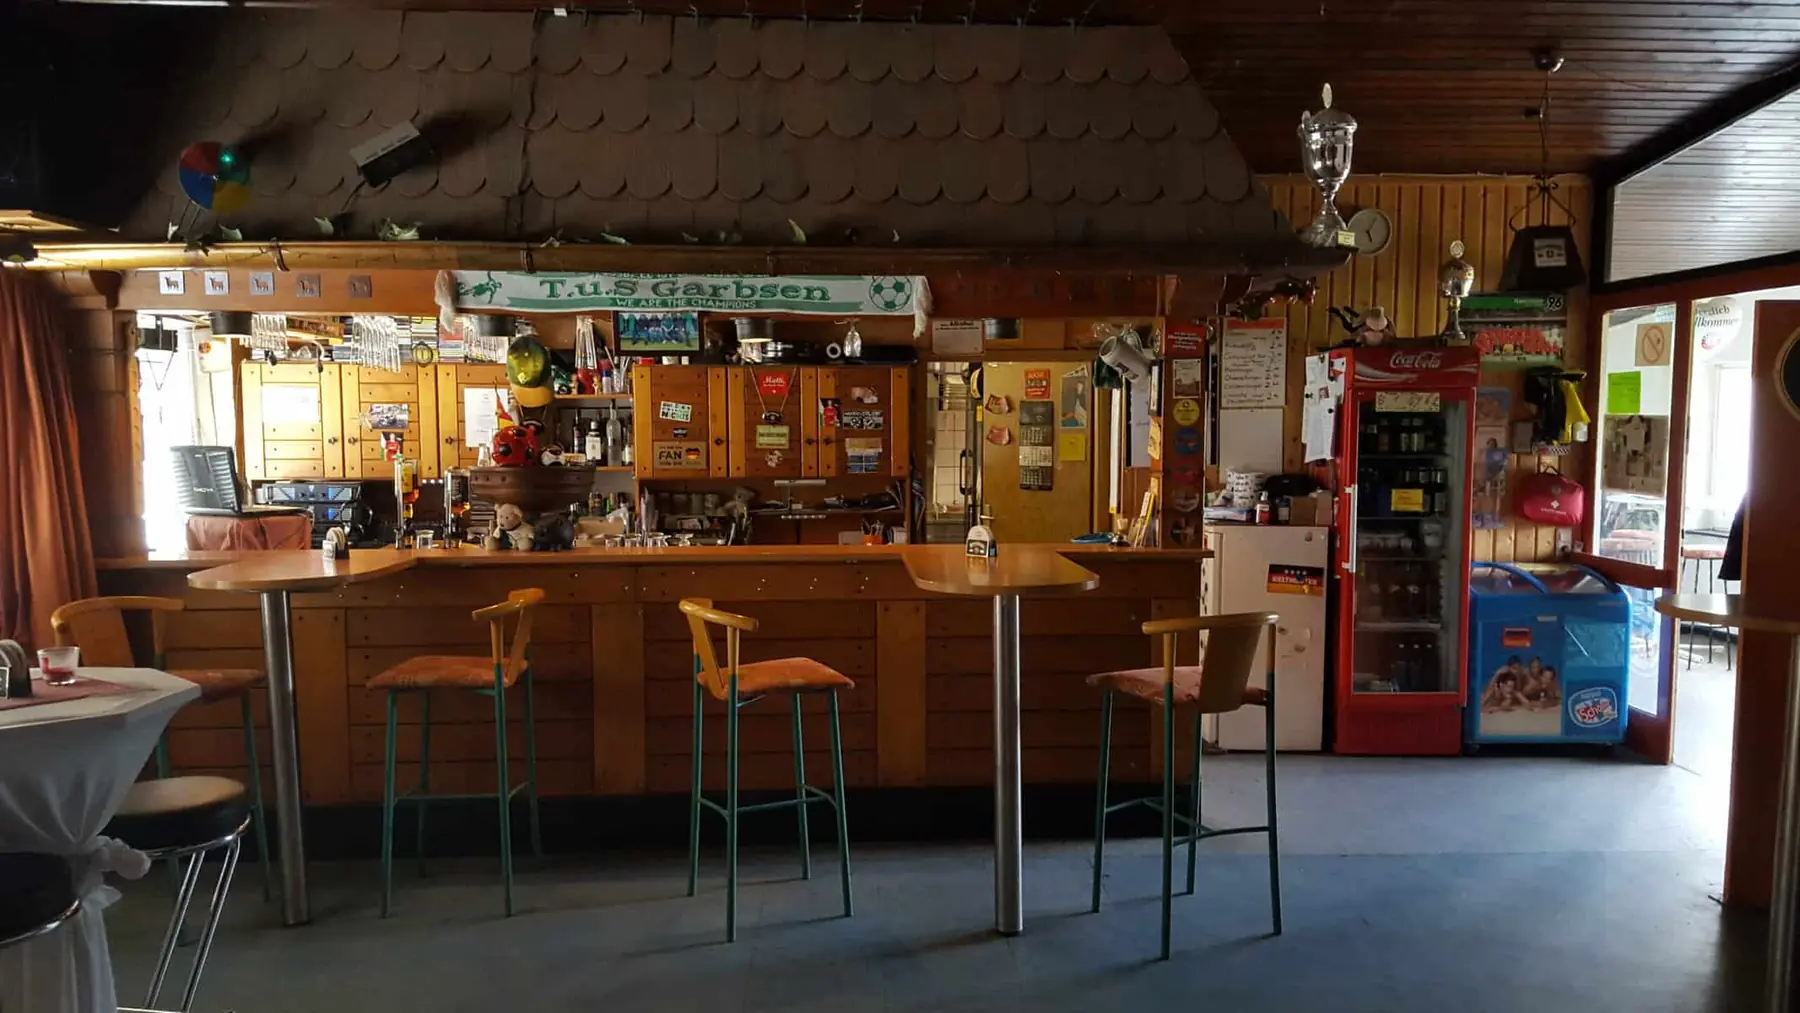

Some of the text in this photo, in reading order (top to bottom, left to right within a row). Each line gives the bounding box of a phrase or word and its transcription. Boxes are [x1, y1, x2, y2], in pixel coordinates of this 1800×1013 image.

[651, 280, 831, 301] Garbsen
[616, 299, 757, 309] WE ARE THE CHAMPIONS
[1547, 296, 1563, 310] 96
[658, 450, 683, 460] FAN
